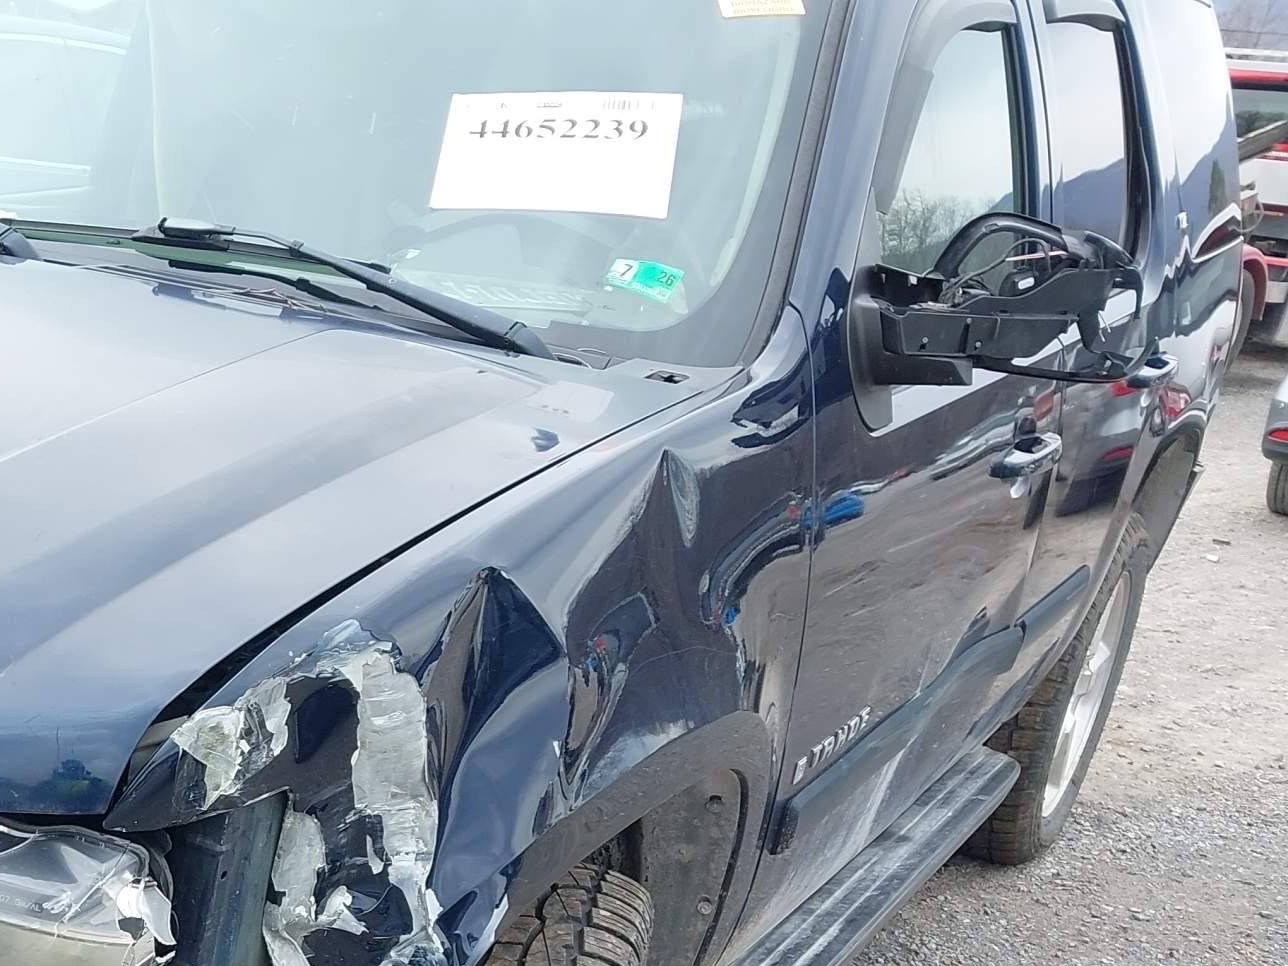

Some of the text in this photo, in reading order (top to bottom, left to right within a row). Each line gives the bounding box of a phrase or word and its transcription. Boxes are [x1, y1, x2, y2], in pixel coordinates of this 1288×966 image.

[468, 119, 649, 139] 44652239
[619, 263, 677, 287] 7 26
